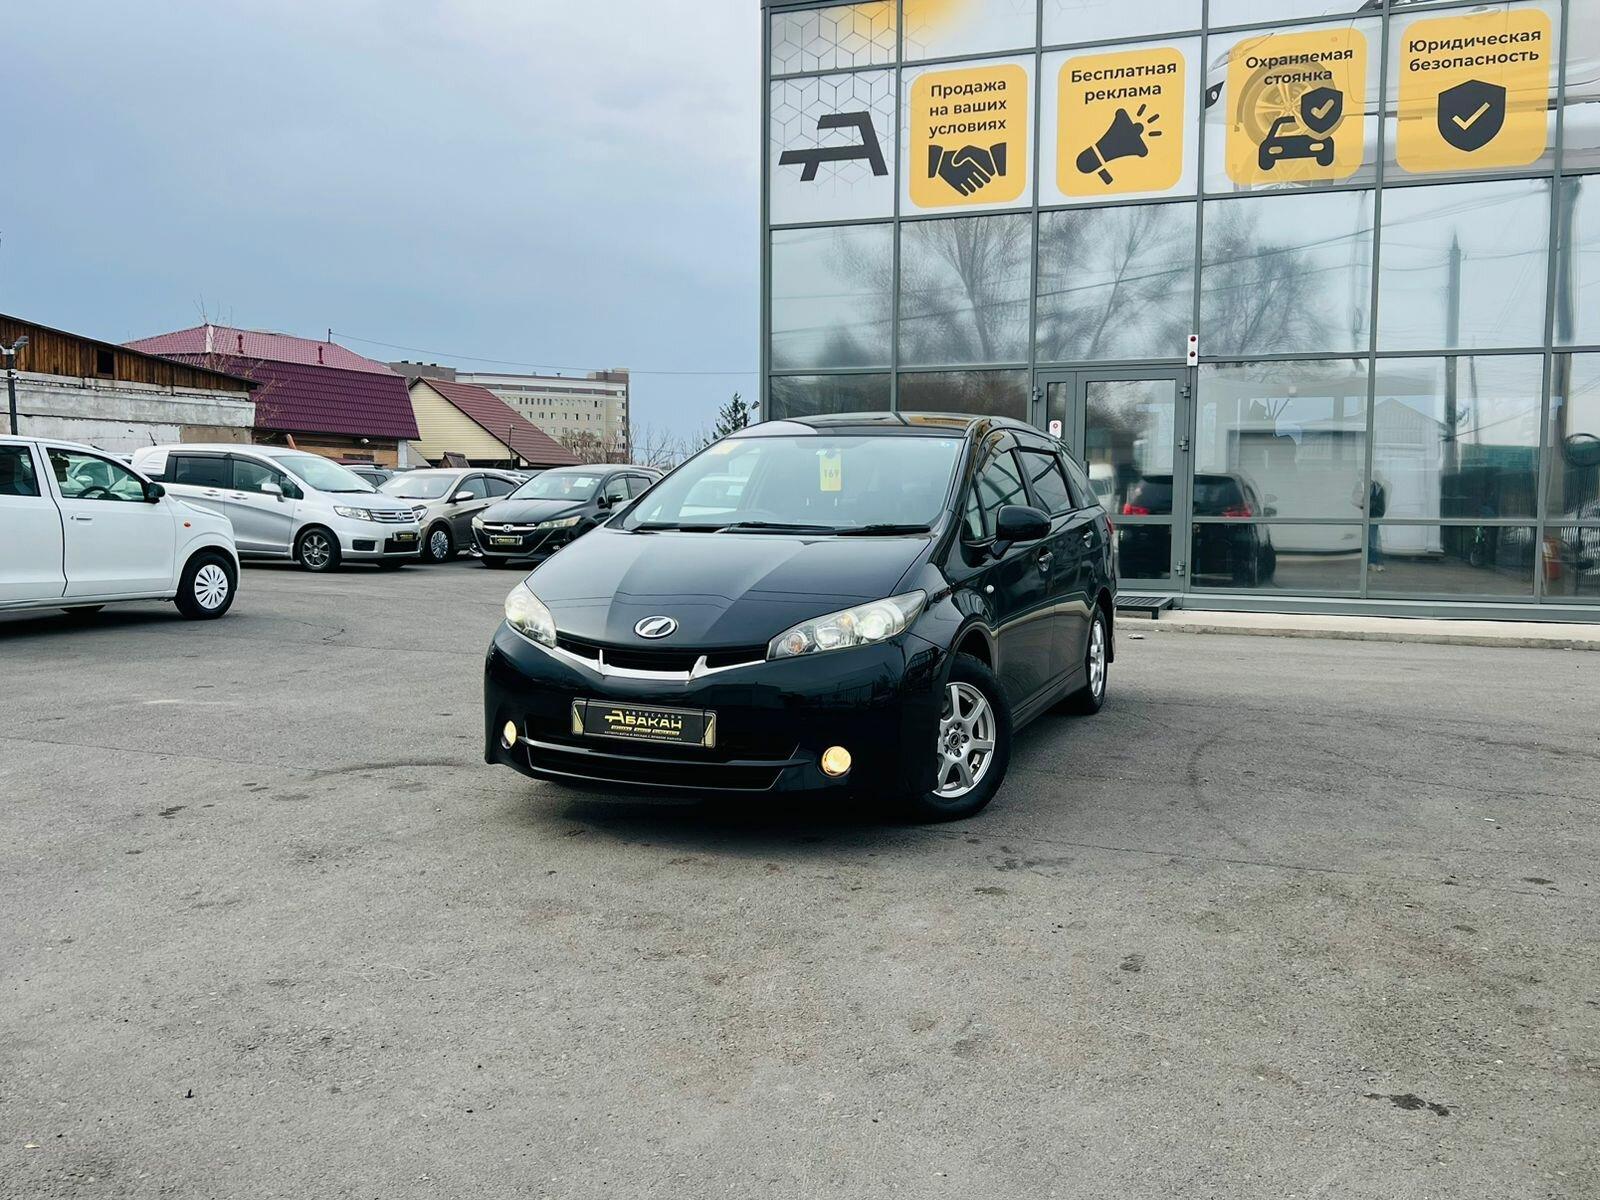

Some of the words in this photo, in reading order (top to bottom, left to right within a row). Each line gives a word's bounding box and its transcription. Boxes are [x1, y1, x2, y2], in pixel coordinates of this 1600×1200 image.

[1409, 30, 1541, 54] Юридическая
[1245, 49, 1353, 70] Охраняемая
[1409, 50, 1539, 72] безопасность
[1071, 62, 1177, 83] Бесплатная
[1263, 69, 1333, 85] стоянка
[930, 79, 1007, 98] Продажа
[1084, 83, 1162, 104] реклама
[929, 105, 949, 117] на
[953, 98, 1007, 115] ваших
[928, 118, 1007, 138] условиях
